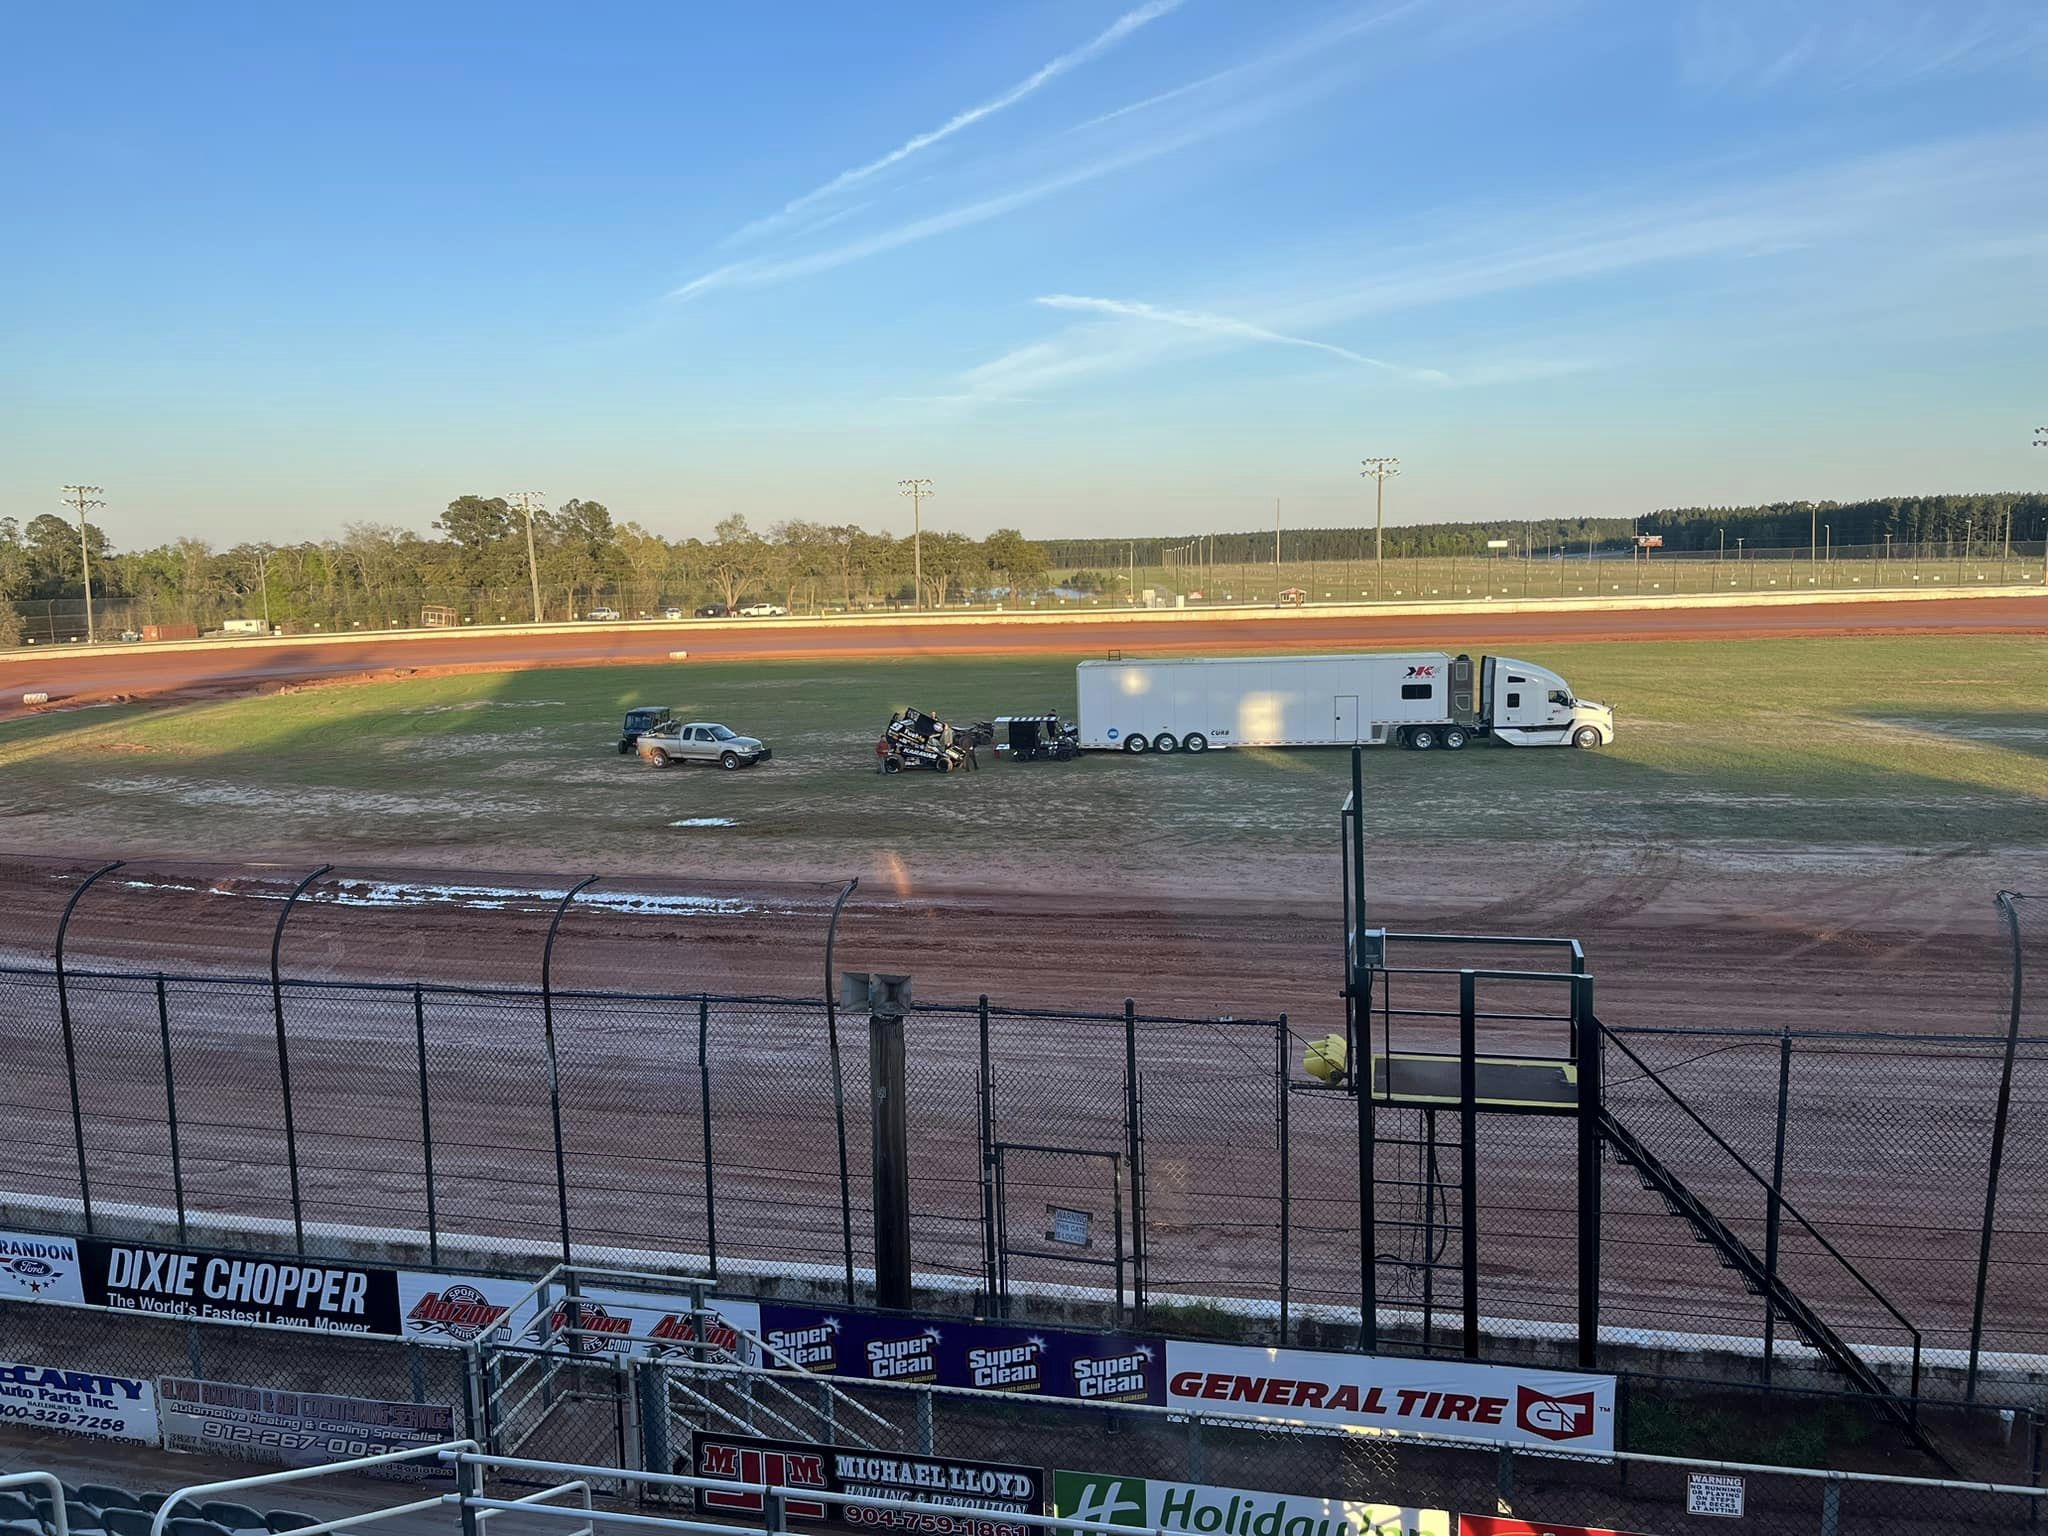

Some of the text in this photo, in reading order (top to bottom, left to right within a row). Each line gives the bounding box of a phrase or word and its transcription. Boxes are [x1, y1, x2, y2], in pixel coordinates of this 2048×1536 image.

[20, 1261, 45, 1274] Ford
[108, 1248, 368, 1314] DIXIE CHOPPER
[449, 1289, 481, 1301] SPORT
[107, 1293, 371, 1333] The World's Fastest Lawn Mower
[604, 1340, 632, 1353] .com
[768, 1327, 833, 1349] Super
[867, 1337, 934, 1360] Super
[873, 1356, 933, 1378] Clean
[969, 1346, 1037, 1369] Super
[1074, 1355, 1144, 1378] Super
[975, 1365, 1037, 1387] Clean
[1080, 1375, 1144, 1397] Clean
[39, 1388, 81, 1405] Parts
[87, 1395, 118, 1410] Inc.
[1170, 1372, 1510, 1425] GENERAL TIRE
[171, 1403, 444, 1443] Automotive Heating & Cooling Specialist
[836, 1455, 1033, 1498] MICHAEL LLOYD
[1692, 1475, 1742, 1486] WARNING
[932, 1496, 1029, 1515] DEMOLITION
[1706, 1491, 1740, 1499] PLAYING
[1710, 1501, 1736, 1509] DECKS
[846, 1506, 1030, 1536] 904-759-1861
